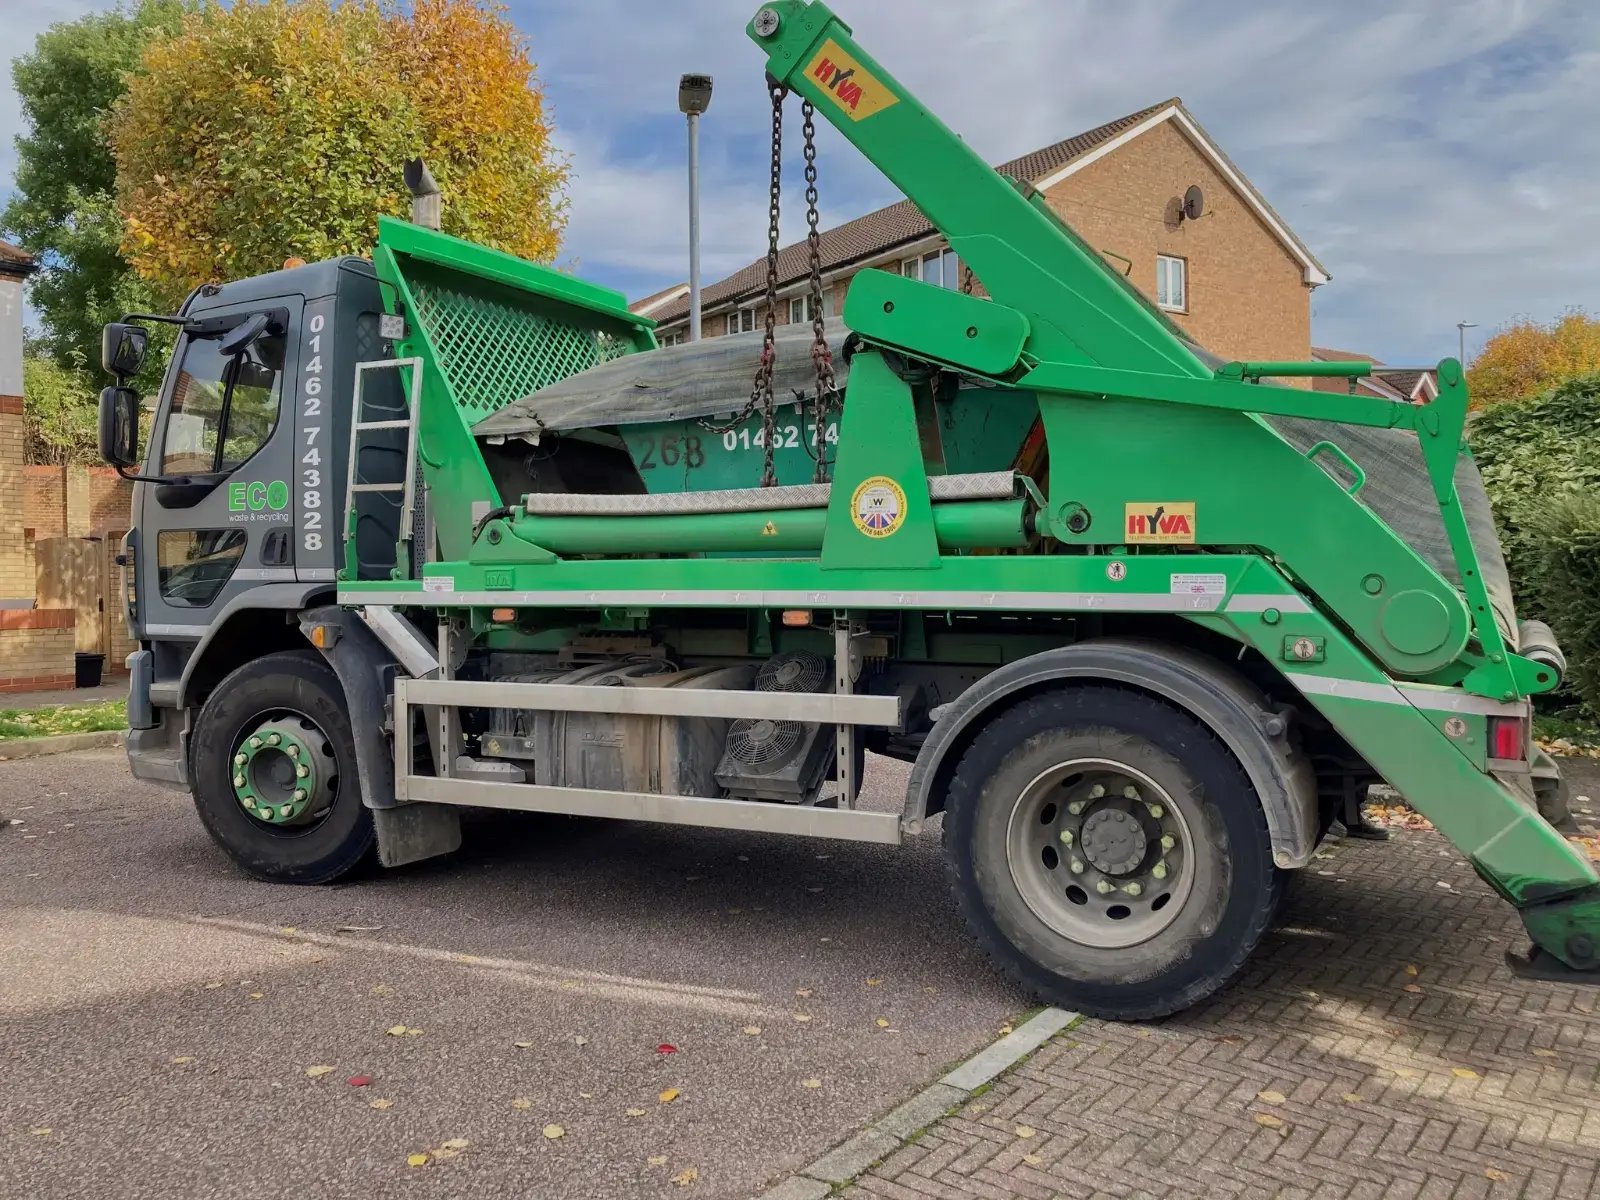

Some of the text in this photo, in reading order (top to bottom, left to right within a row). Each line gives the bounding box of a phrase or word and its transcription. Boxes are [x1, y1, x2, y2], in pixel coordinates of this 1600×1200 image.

[813, 58, 862, 111] HYVA
[302, 315, 325, 550] 01462 743828
[229, 480, 289, 511] ECO
[229, 512, 289, 522] waste & recycling
[1128, 506, 1191, 534] HYVA
